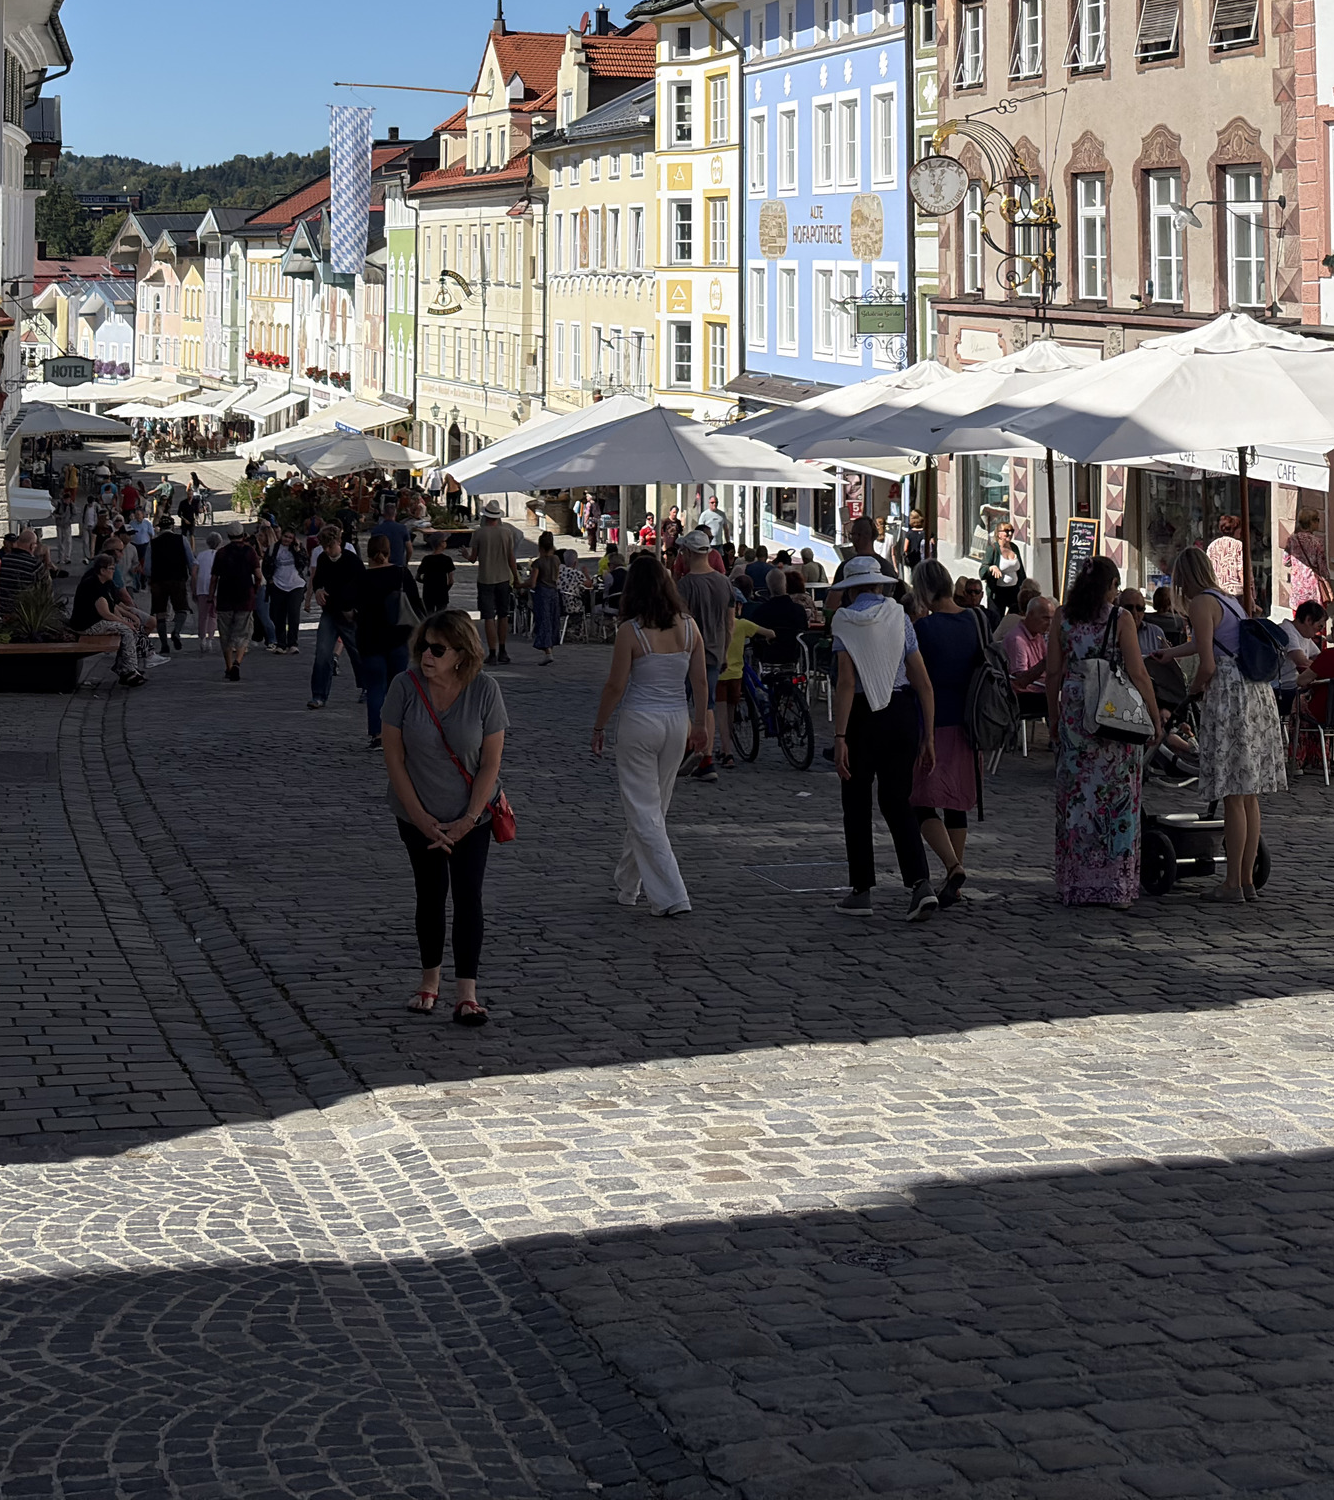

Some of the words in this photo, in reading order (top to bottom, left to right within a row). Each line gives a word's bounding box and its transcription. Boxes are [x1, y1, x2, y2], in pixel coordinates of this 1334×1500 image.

[913, 187, 964, 212] TRACHTENSTUBE
[810, 205, 823, 219] ALTE
[792, 224, 843, 244] HOFAPOTHEKE
[51, 365, 87, 378] HOTEL
[1277, 463, 1297, 482] CAFE
